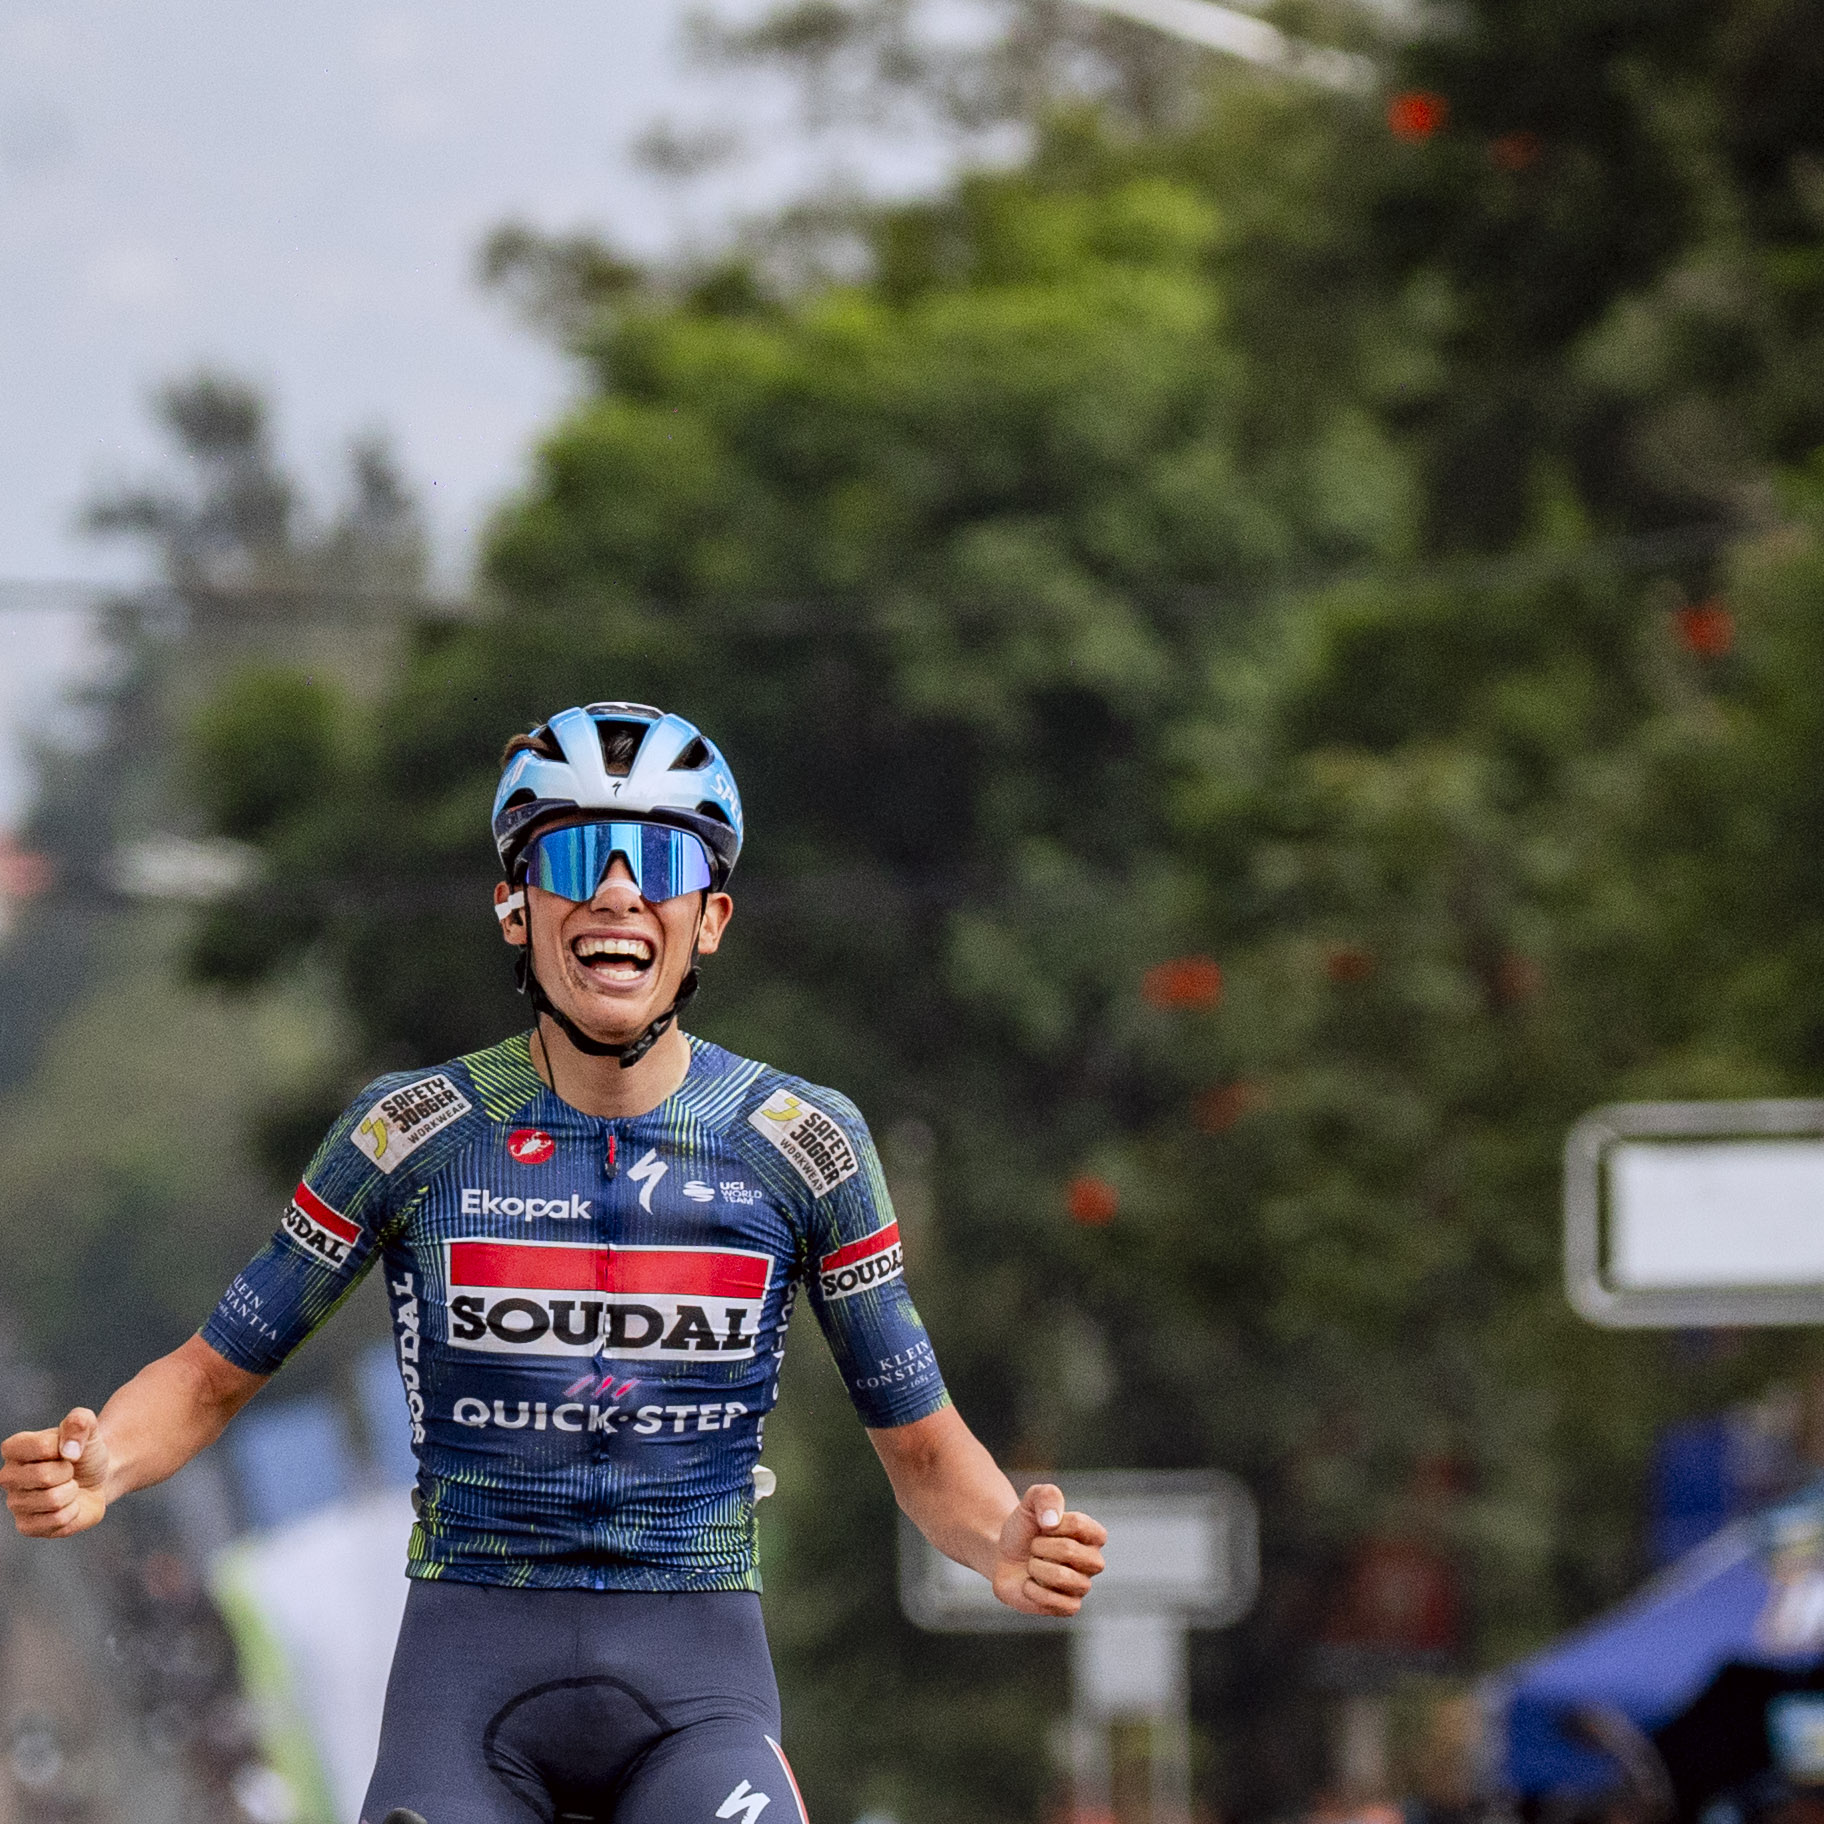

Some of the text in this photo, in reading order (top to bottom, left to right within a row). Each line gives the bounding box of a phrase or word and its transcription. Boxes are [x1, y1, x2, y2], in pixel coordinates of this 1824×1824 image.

[380, 1077, 445, 1118] SAFETY
[392, 1089, 459, 1134] JOGGER
[407, 1102, 466, 1144] WORKWEAR
[804, 1112, 855, 1172] SAFETY
[780, 1138, 824, 1192] WORKWEAR
[789, 1124, 840, 1186] JOGGER
[461, 1188, 592, 1222] Ekopak
[719, 1181, 744, 1190] UCI
[720, 1190, 763, 1199] WORLD
[723, 1196, 754, 1206] TEAM
[284, 1205, 345, 1264] UDAL
[821, 1246, 904, 1297] SOUDA
[450, 1296, 754, 1351] SOUDAL
[393, 1273, 426, 1446] SOUDAL
[856, 1350, 936, 1389] CONSTAN
[879, 1339, 931, 1371] KLEIN
